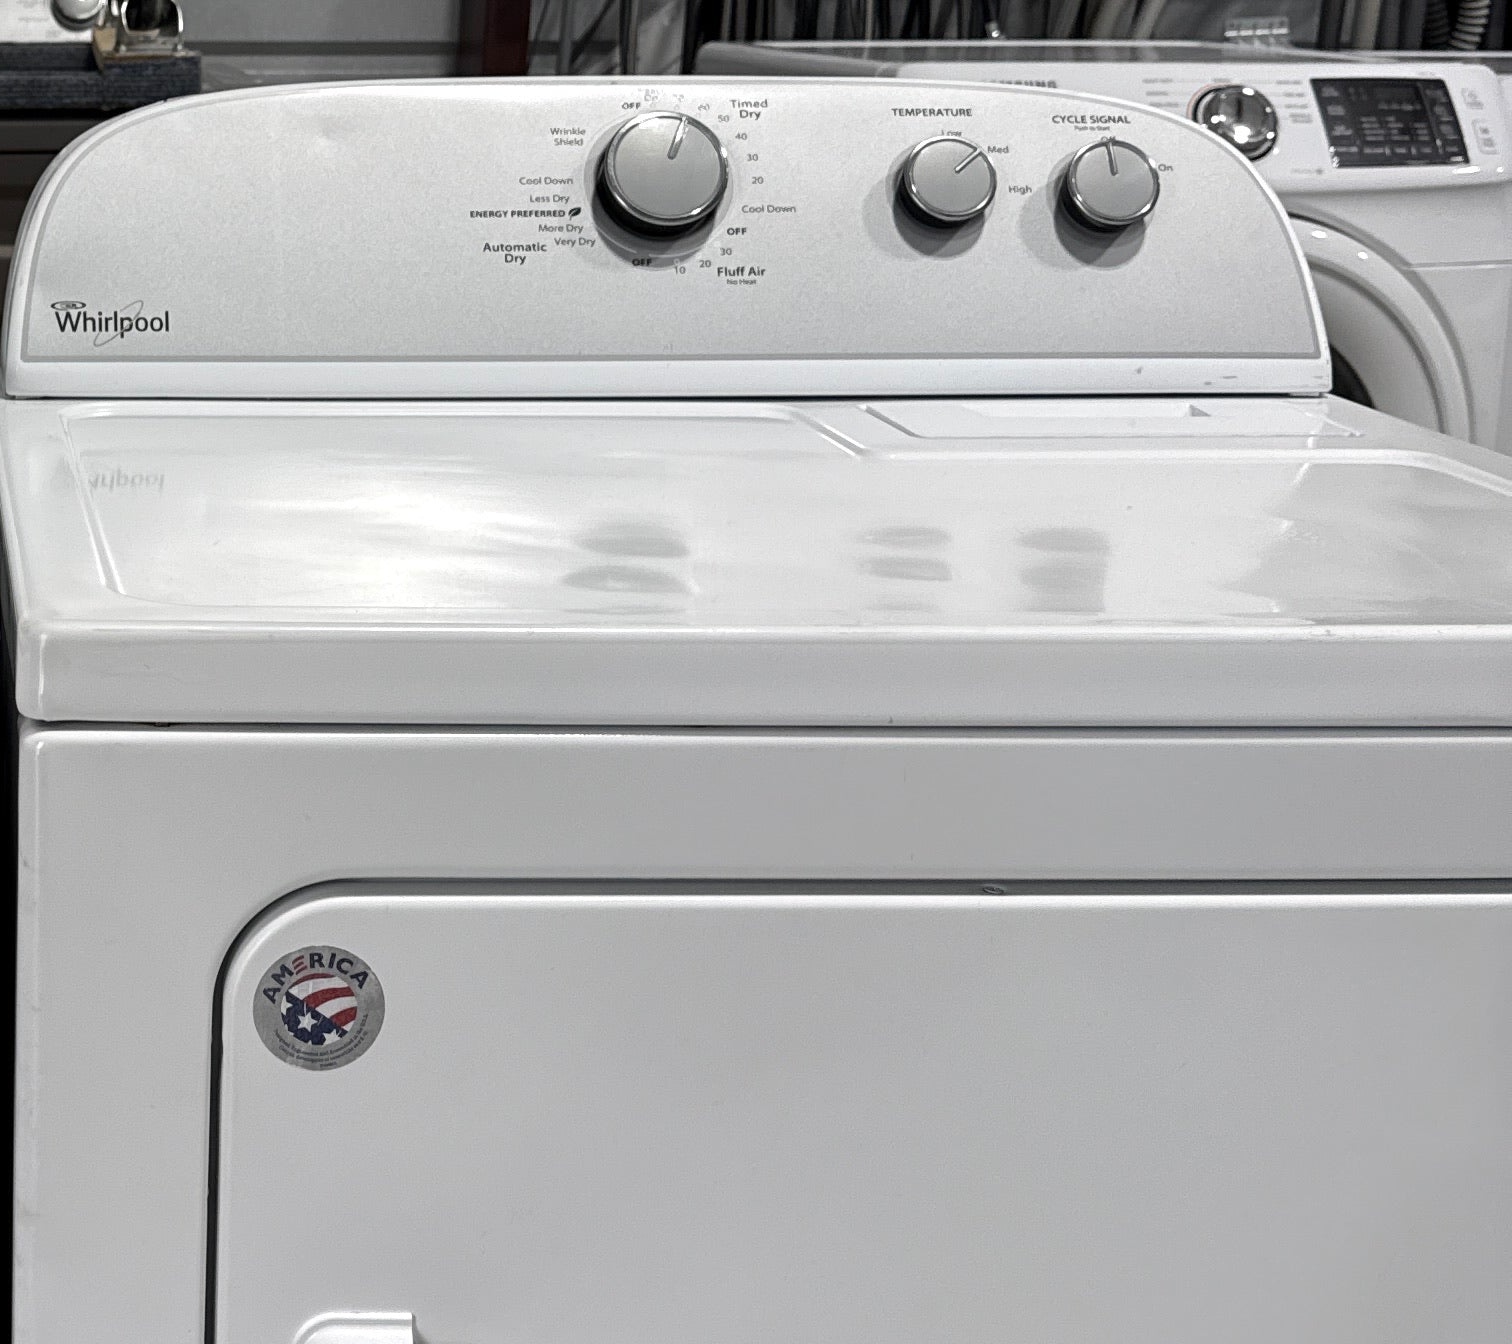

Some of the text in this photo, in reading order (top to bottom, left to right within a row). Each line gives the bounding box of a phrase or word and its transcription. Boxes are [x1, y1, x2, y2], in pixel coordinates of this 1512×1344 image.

[621, 102, 642, 110] OFF
[730, 99, 768, 109] Timed
[739, 109, 762, 120] Dry
[891, 108, 973, 118] TEMPERATURE
[1051, 115, 1132, 124] CYCLE SIGNAL
[550, 127, 586, 136] Wrinkle
[554, 137, 584, 146] Shield
[735, 132, 748, 142] 40
[988, 145, 1010, 154] Med
[746, 153, 760, 162] 30
[1158, 163, 1174, 172] On
[519, 176, 574, 186] Cool Down
[751, 176, 764, 185] 20
[1008, 185, 1033, 196] High
[530, 194, 570, 206] Less Dry
[470, 209, 566, 218] ENERGY PREFERRED
[742, 204, 796, 214] Cool Down
[539, 224, 584, 236] More Dry
[727, 227, 748, 236] OFF
[483, 242, 547, 253] Automatic
[554, 237, 596, 248] Very Dry
[720, 247, 733, 256] 30
[504, 253, 527, 266] Dry
[632, 258, 652, 267] OFF
[699, 259, 712, 268] 20
[675, 266, 686, 274] 10
[717, 267, 766, 277] Fluff Air
[54, 307, 170, 340] Whirlpool
[263, 952, 370, 1004] AMERICA
